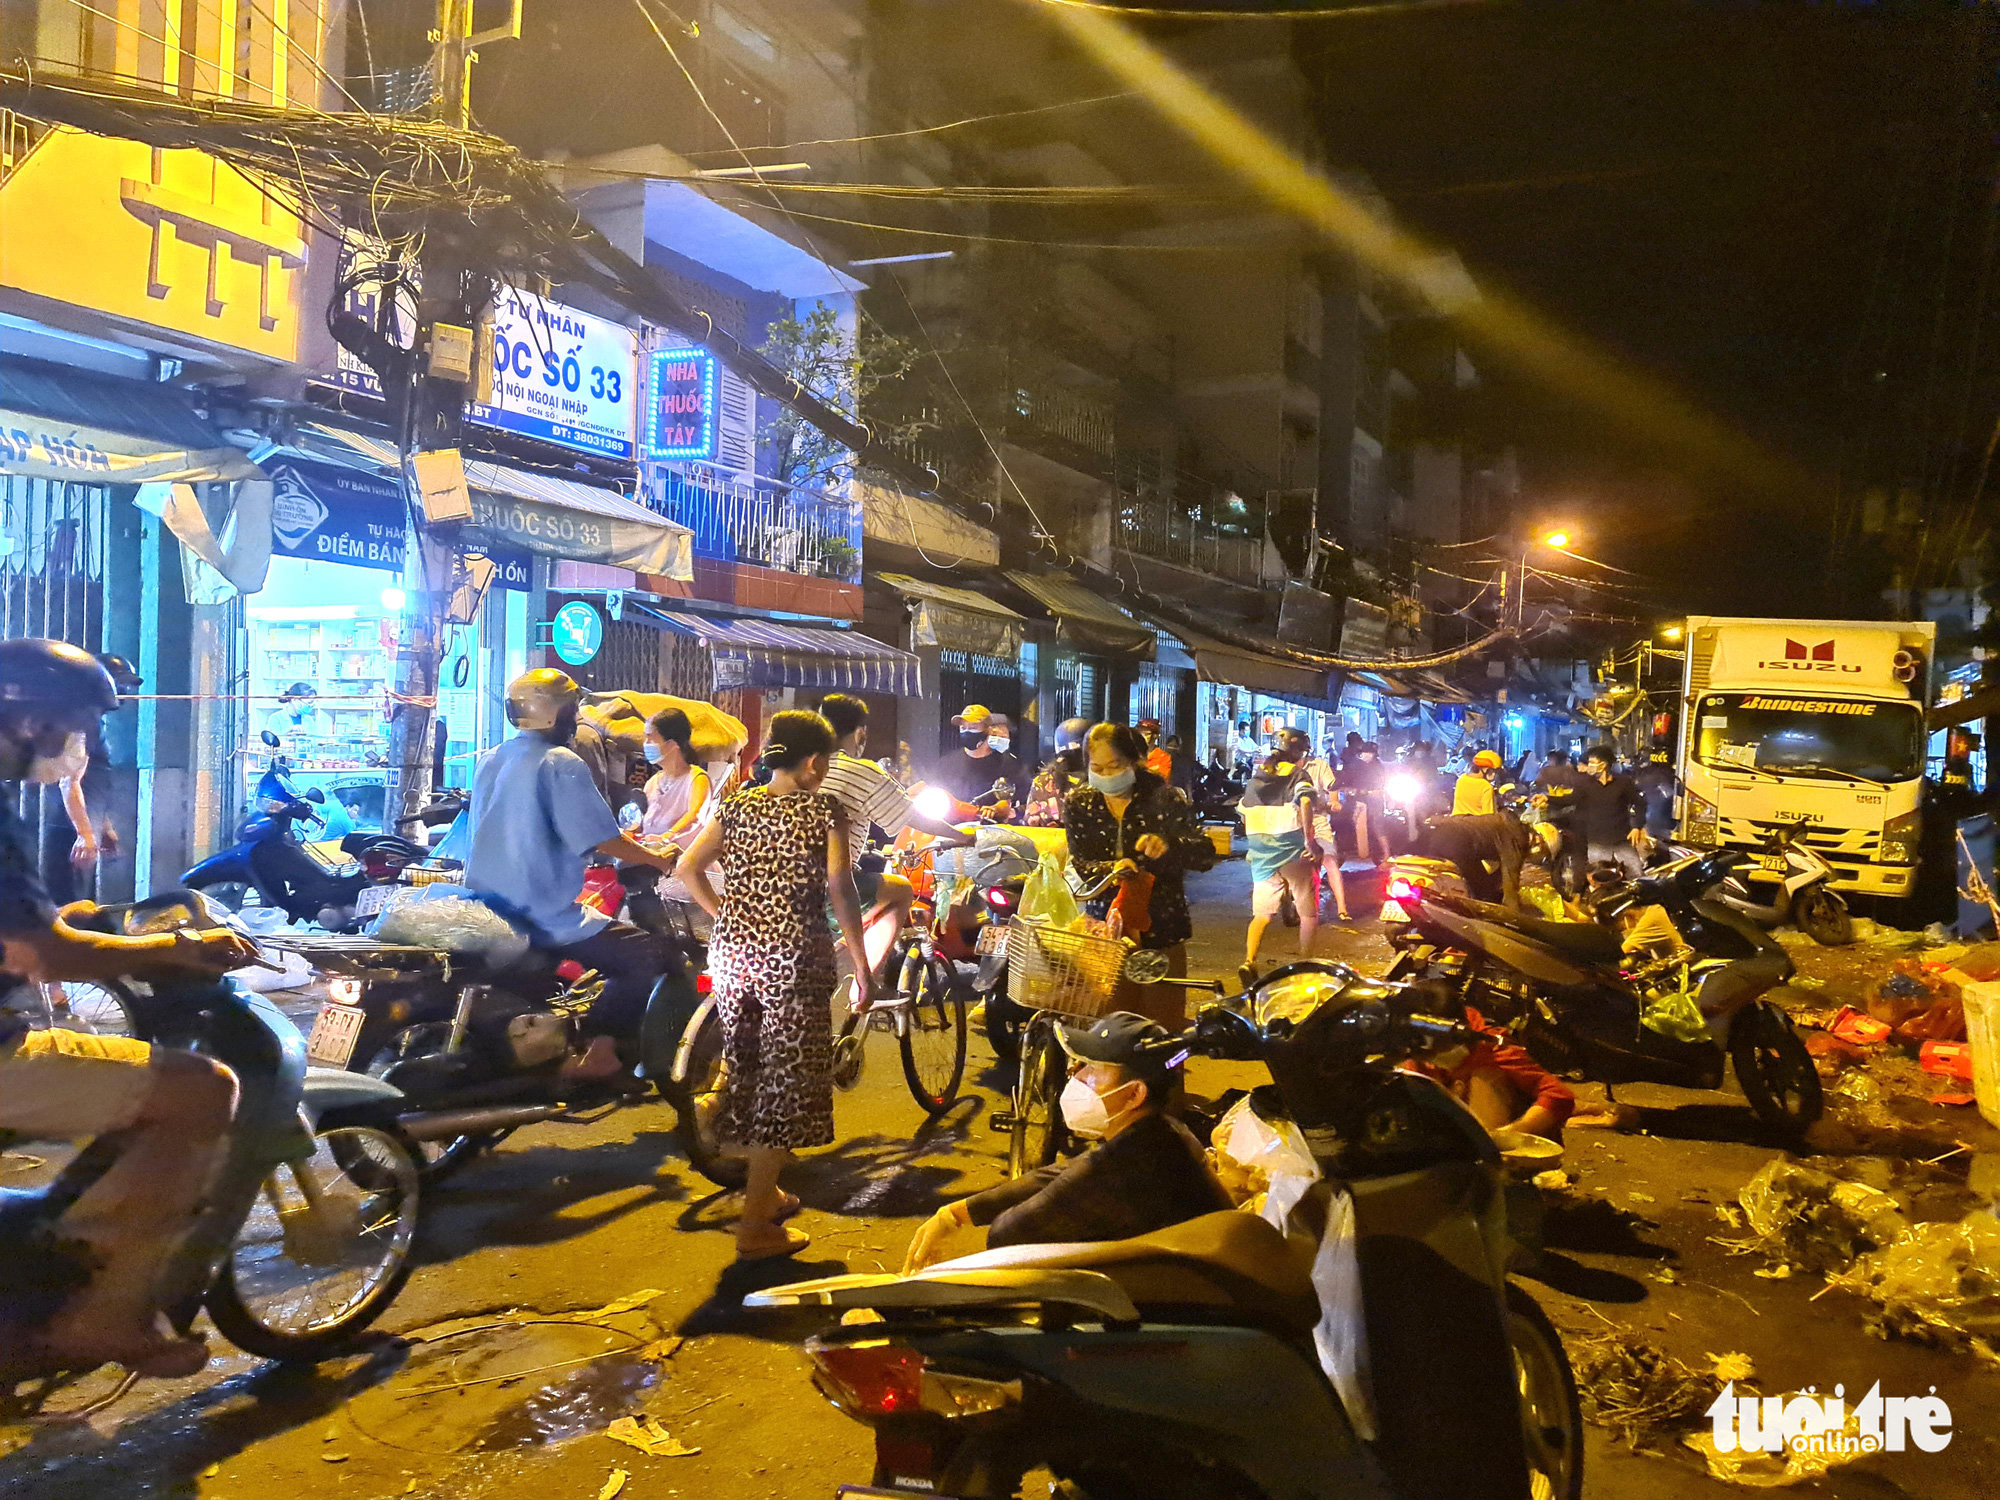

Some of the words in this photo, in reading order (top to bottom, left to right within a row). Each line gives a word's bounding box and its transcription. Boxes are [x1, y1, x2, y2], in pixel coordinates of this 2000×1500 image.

[537, 308, 586, 339] NHÂN
[340, 371, 358, 386] 15
[543, 345, 583, 393] SỐ
[590, 366, 622, 403] 33
[666, 357, 698, 382] NHÀ
[506, 382, 524, 405] NỘI
[527, 388, 558, 414] NGOẠI
[561, 398, 588, 418] NHẬP
[526, 405, 543, 416] GCN
[658, 387, 705, 414] THUỐC
[552, 424, 571, 439] ĐT:
[574, 430, 624, 452] 38031369
[665, 426, 695, 446] TÂY
[580, 522, 601, 547] 33
[317, 531, 364, 559] ĐIỂM
[368, 540, 405, 565] BÁN
[1758, 661, 1862, 673] ISUZU
[1739, 696, 1877, 716] BRIDGESTONE
[1774, 810, 1824, 823] ISUZU
[894, 1474, 935, 1490] HONDA
